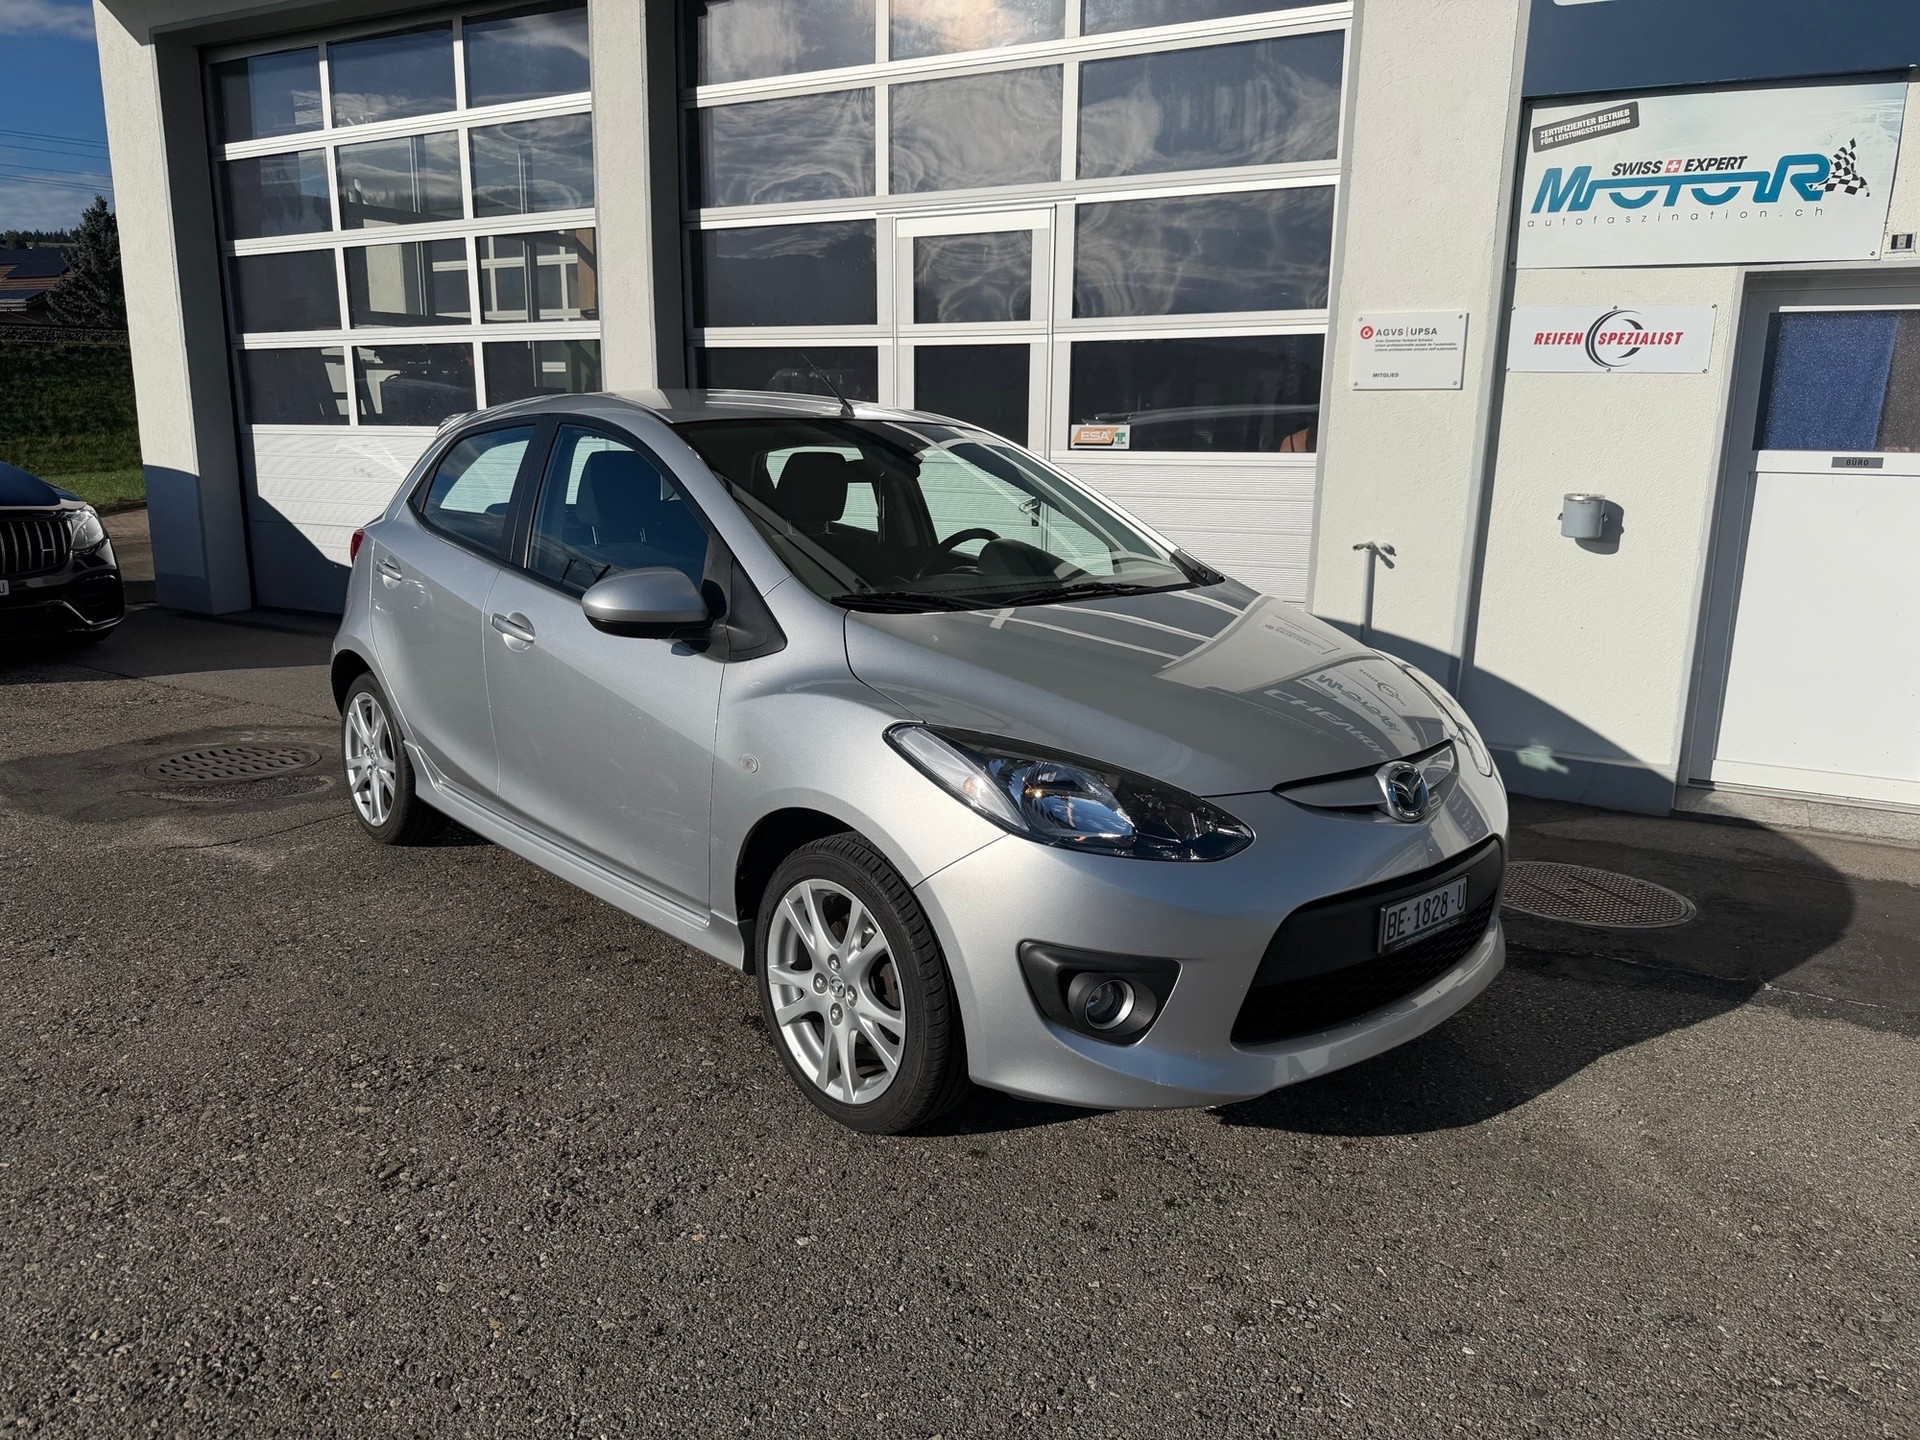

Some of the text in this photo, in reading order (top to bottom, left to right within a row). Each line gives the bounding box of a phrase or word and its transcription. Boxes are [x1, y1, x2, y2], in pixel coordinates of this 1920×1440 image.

[1540, 108, 1630, 138] ZERTIFIZIERTER BETRIEB
[1540, 117, 1631, 146] FÜR LEISTUNGSSTEIGERUNG
[1611, 155, 1749, 177] SWISS EXPERT
[1526, 206, 1824, 228] autofaszination.ch
[1375, 327, 1438, 337] AGVS UPSA
[1533, 331, 1684, 346] REIFEN SPEZIALIST
